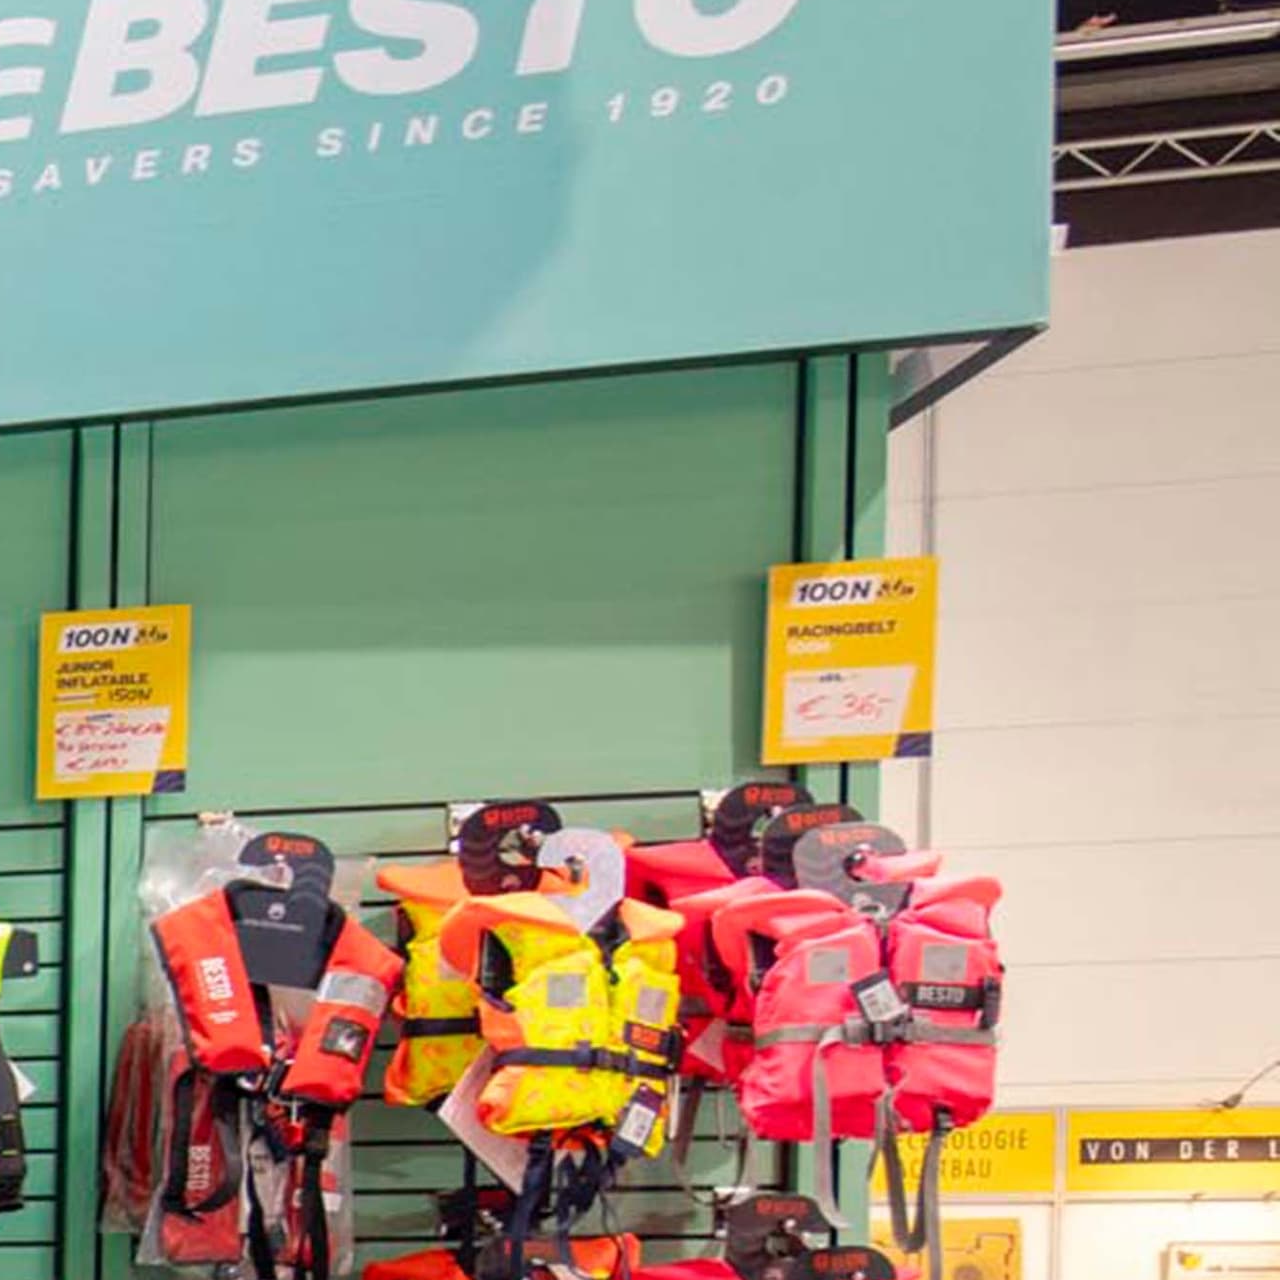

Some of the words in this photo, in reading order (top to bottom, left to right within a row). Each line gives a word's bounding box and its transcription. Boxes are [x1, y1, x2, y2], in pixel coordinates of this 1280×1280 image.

[316, 102, 549, 158] SINCE
[604, 73, 791, 123] 1920
[787, 620, 896, 638] RACINGBELT
[57, 673, 149, 690] INFLATABLE
[200, 958, 234, 1001] BESTO
[916, 985, 966, 1005] BESTO
[1087, 1140, 1150, 1161] VON
[1179, 1139, 1240, 1160] DER
[186, 1145, 211, 1192] BESTO
